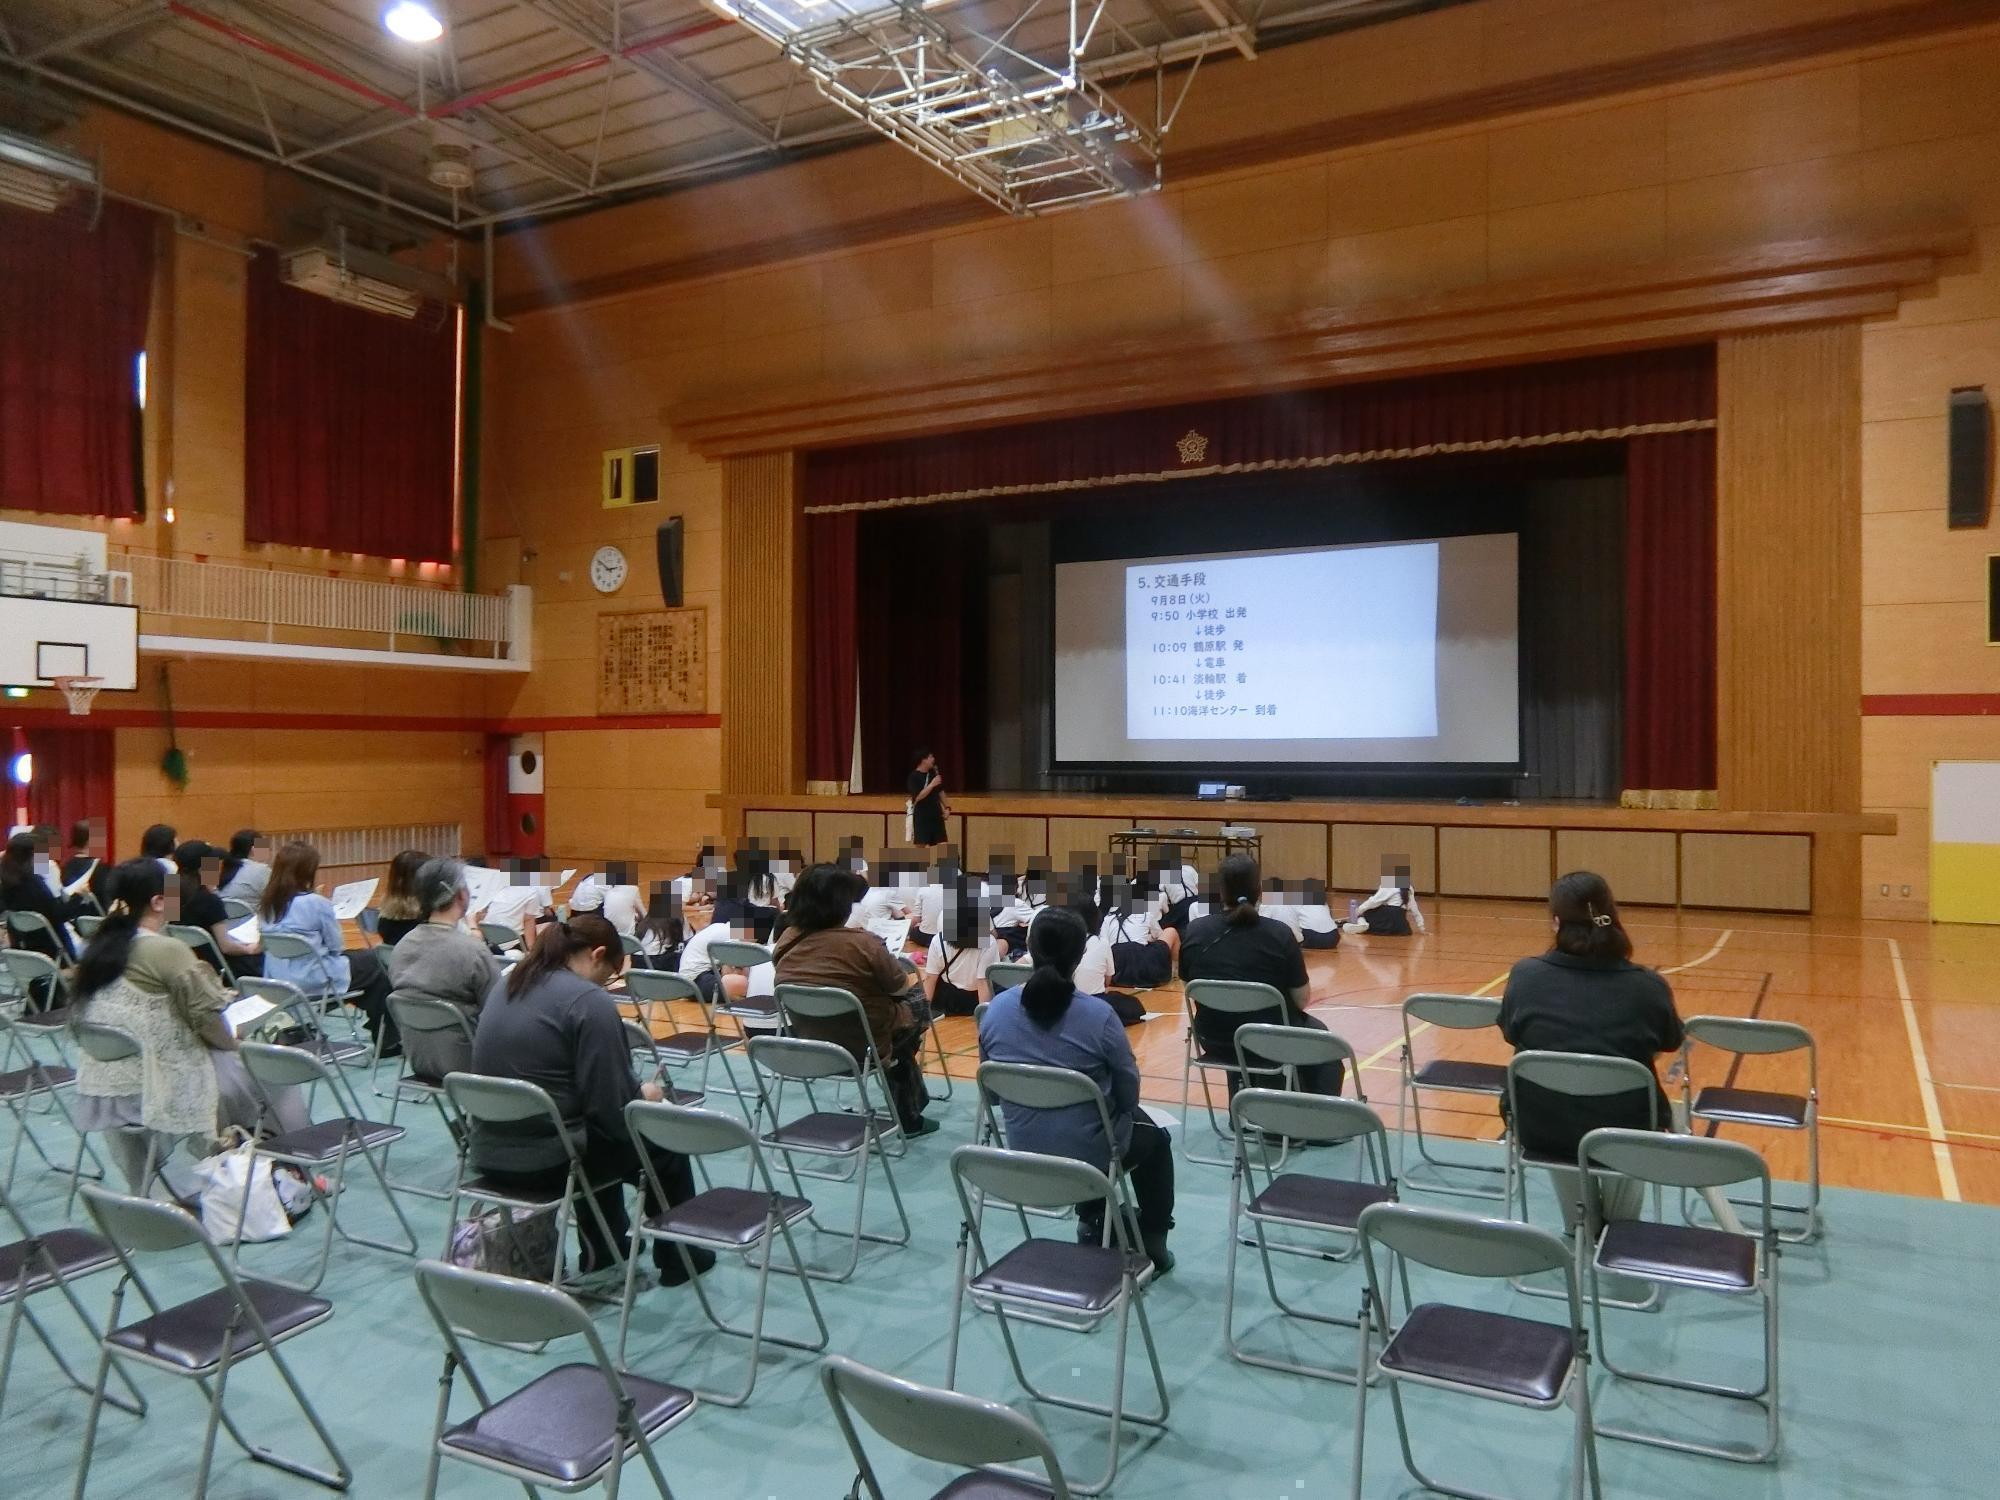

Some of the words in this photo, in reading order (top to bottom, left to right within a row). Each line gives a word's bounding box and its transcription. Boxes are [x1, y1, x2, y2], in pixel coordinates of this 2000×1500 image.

[1151, 610, 1179, 622] 9:50
[1186, 608, 1218, 620] 小学校
[1225, 607, 1247, 619] 出発
[1204, 624, 1226, 636] 徒歩
[1153, 641, 1187, 653] 10:09
[1233, 640, 1244, 651] 発
[1204, 657, 1226, 668] 電車
[1153, 674, 1186, 685] 10:41
[1194, 673, 1227, 685] 淡輪駅
[1236, 672, 1247, 684] 着
[1204, 689, 1226, 700] 徒歩
[1256, 704, 1277, 716] 到着
